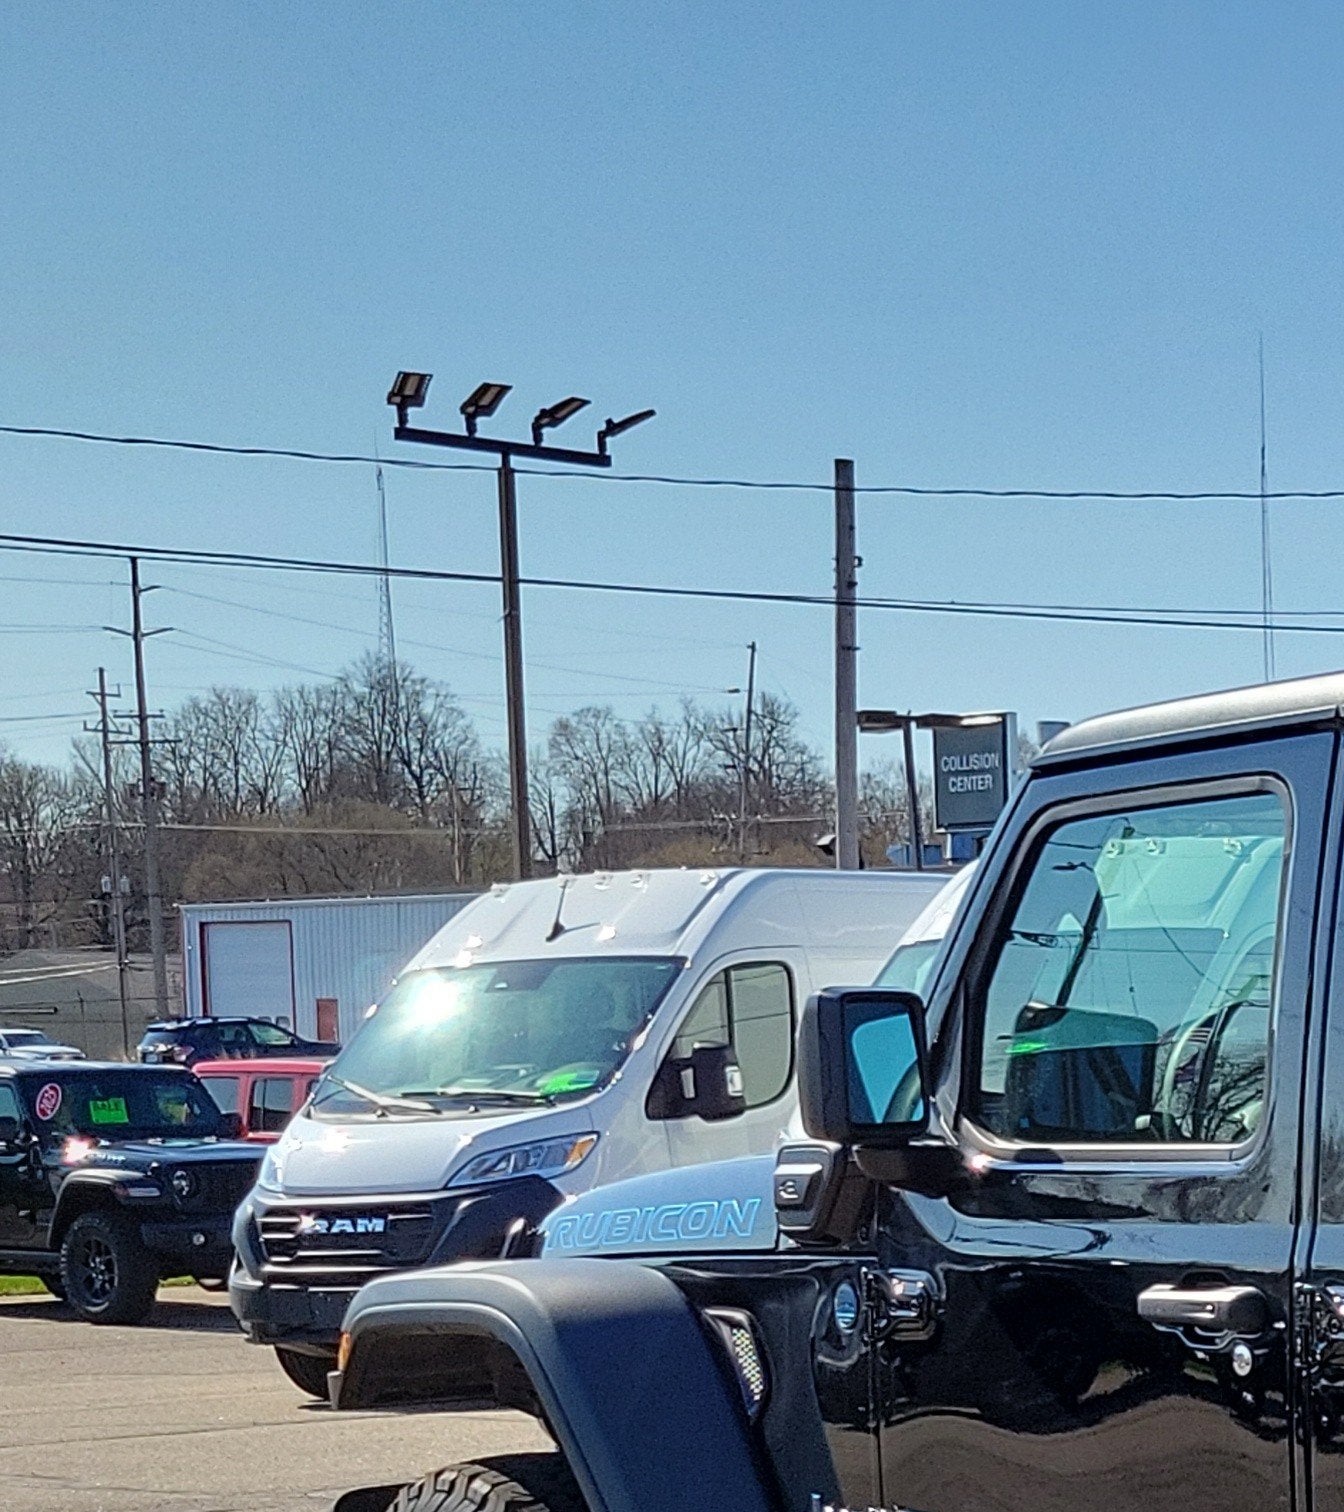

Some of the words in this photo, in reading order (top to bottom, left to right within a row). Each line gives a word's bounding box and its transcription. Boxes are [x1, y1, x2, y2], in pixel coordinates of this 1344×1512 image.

[941, 752, 1000, 772] COLLISION
[948, 774, 994, 793] CENTER
[302, 1217, 386, 1233] RAM
[545, 1199, 762, 1250] RUBICON
